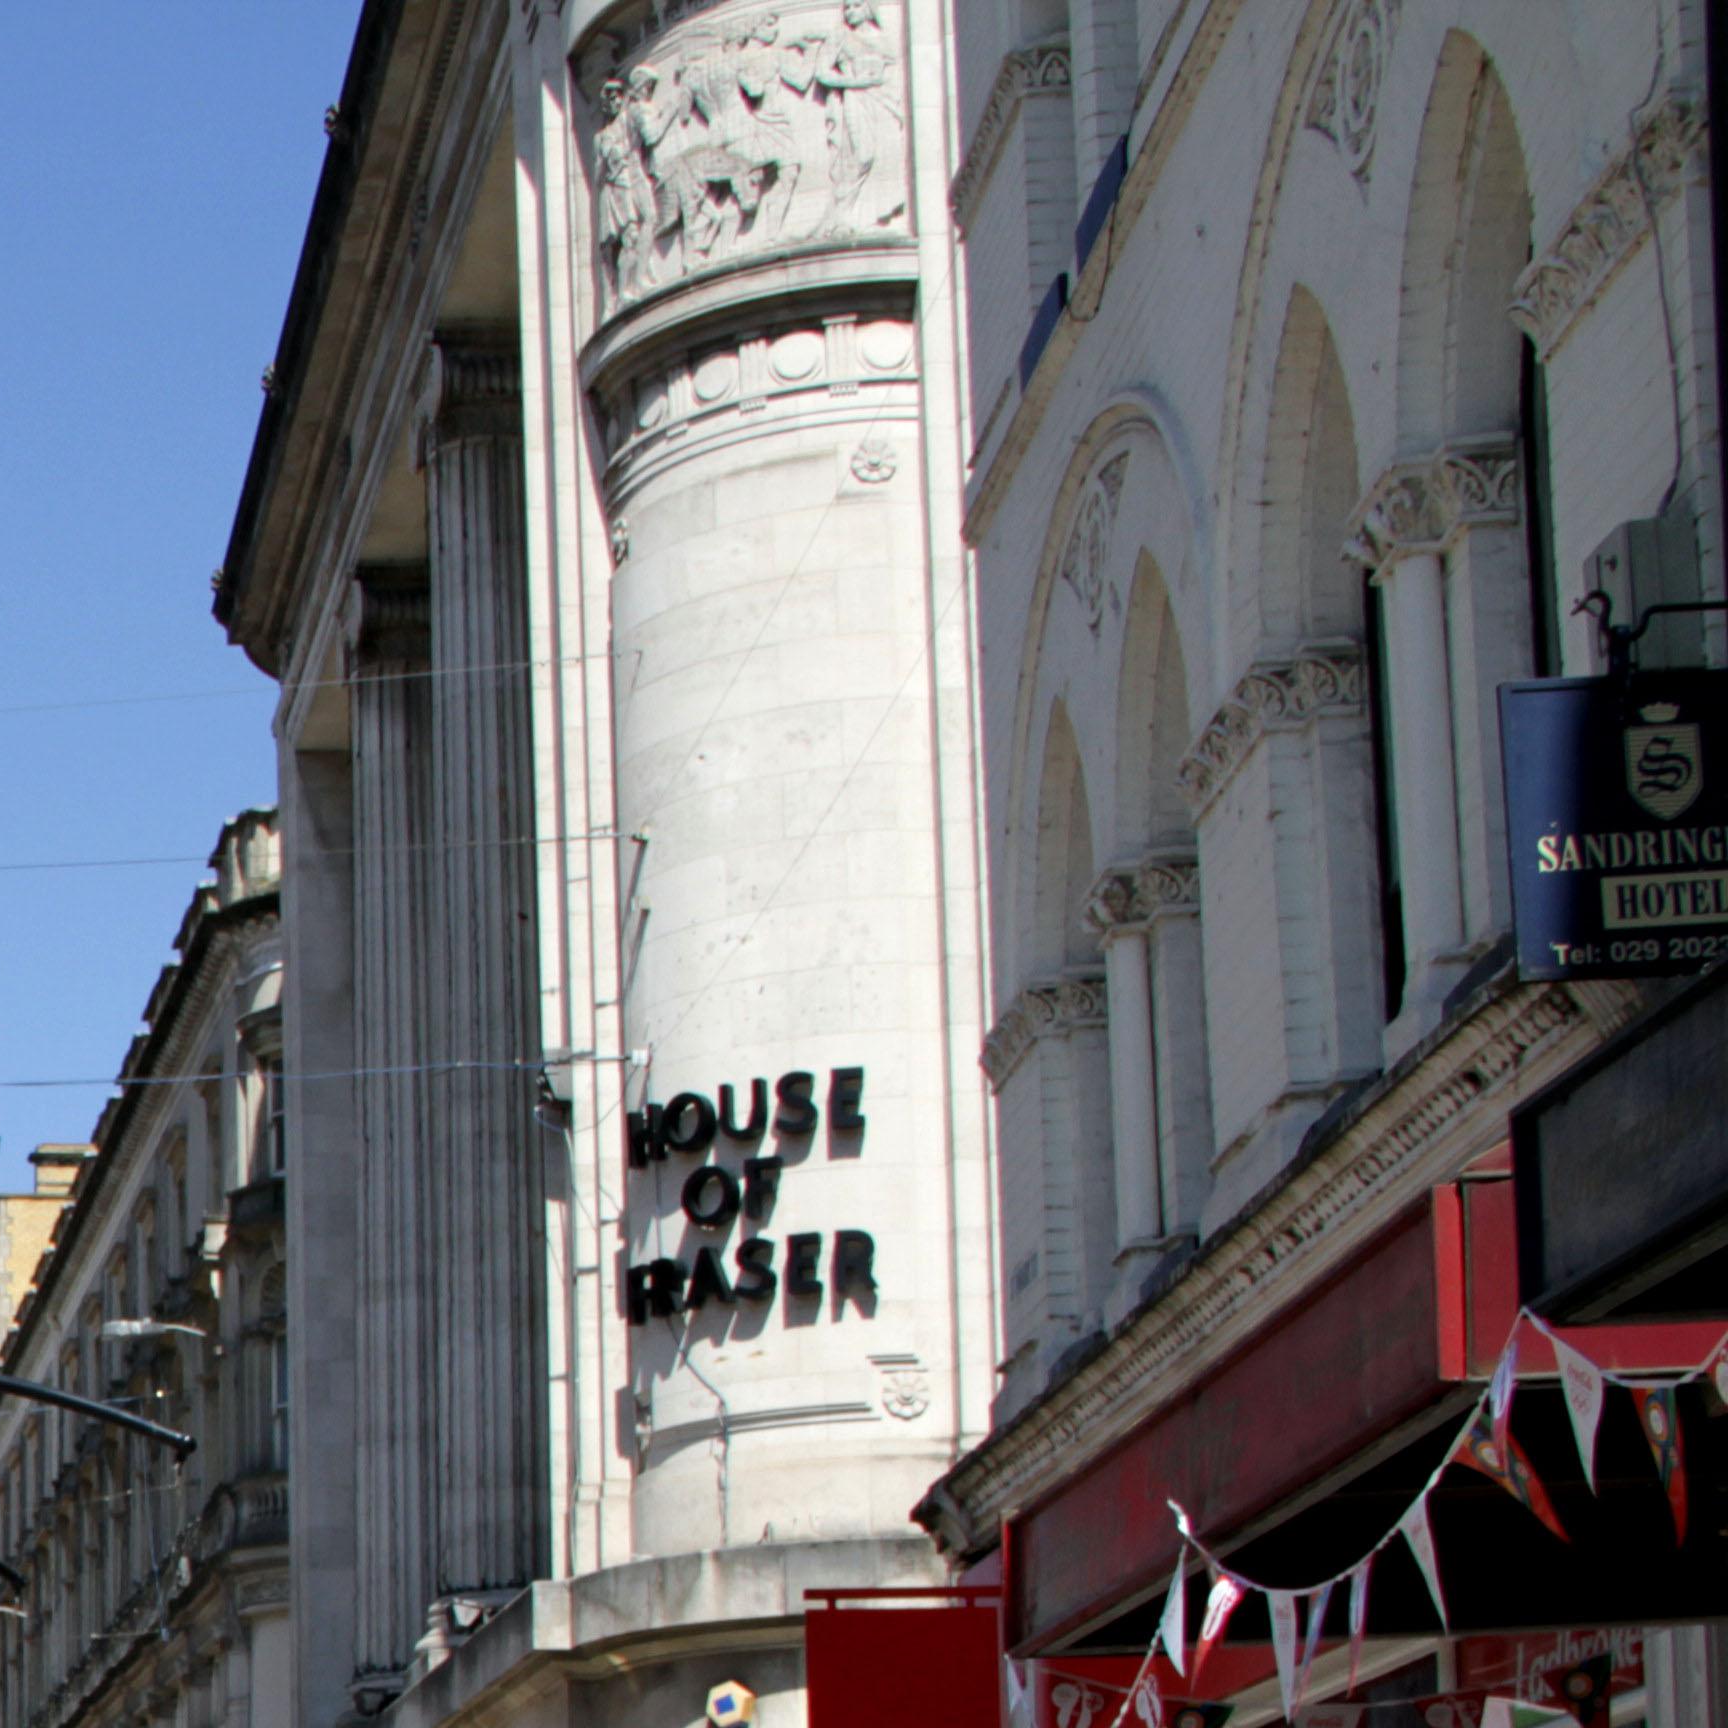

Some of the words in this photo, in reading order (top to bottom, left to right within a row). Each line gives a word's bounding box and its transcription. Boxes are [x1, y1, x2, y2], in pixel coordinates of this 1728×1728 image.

[1537, 829, 1728, 874] SANDRING
[1551, 942, 1601, 967] Tel:
[1610, 942, 1660, 962] 029
[627, 1066, 866, 1168] HOUSE
[681, 1156, 783, 1228] OF
[627, 1230, 878, 1326] FRASER
